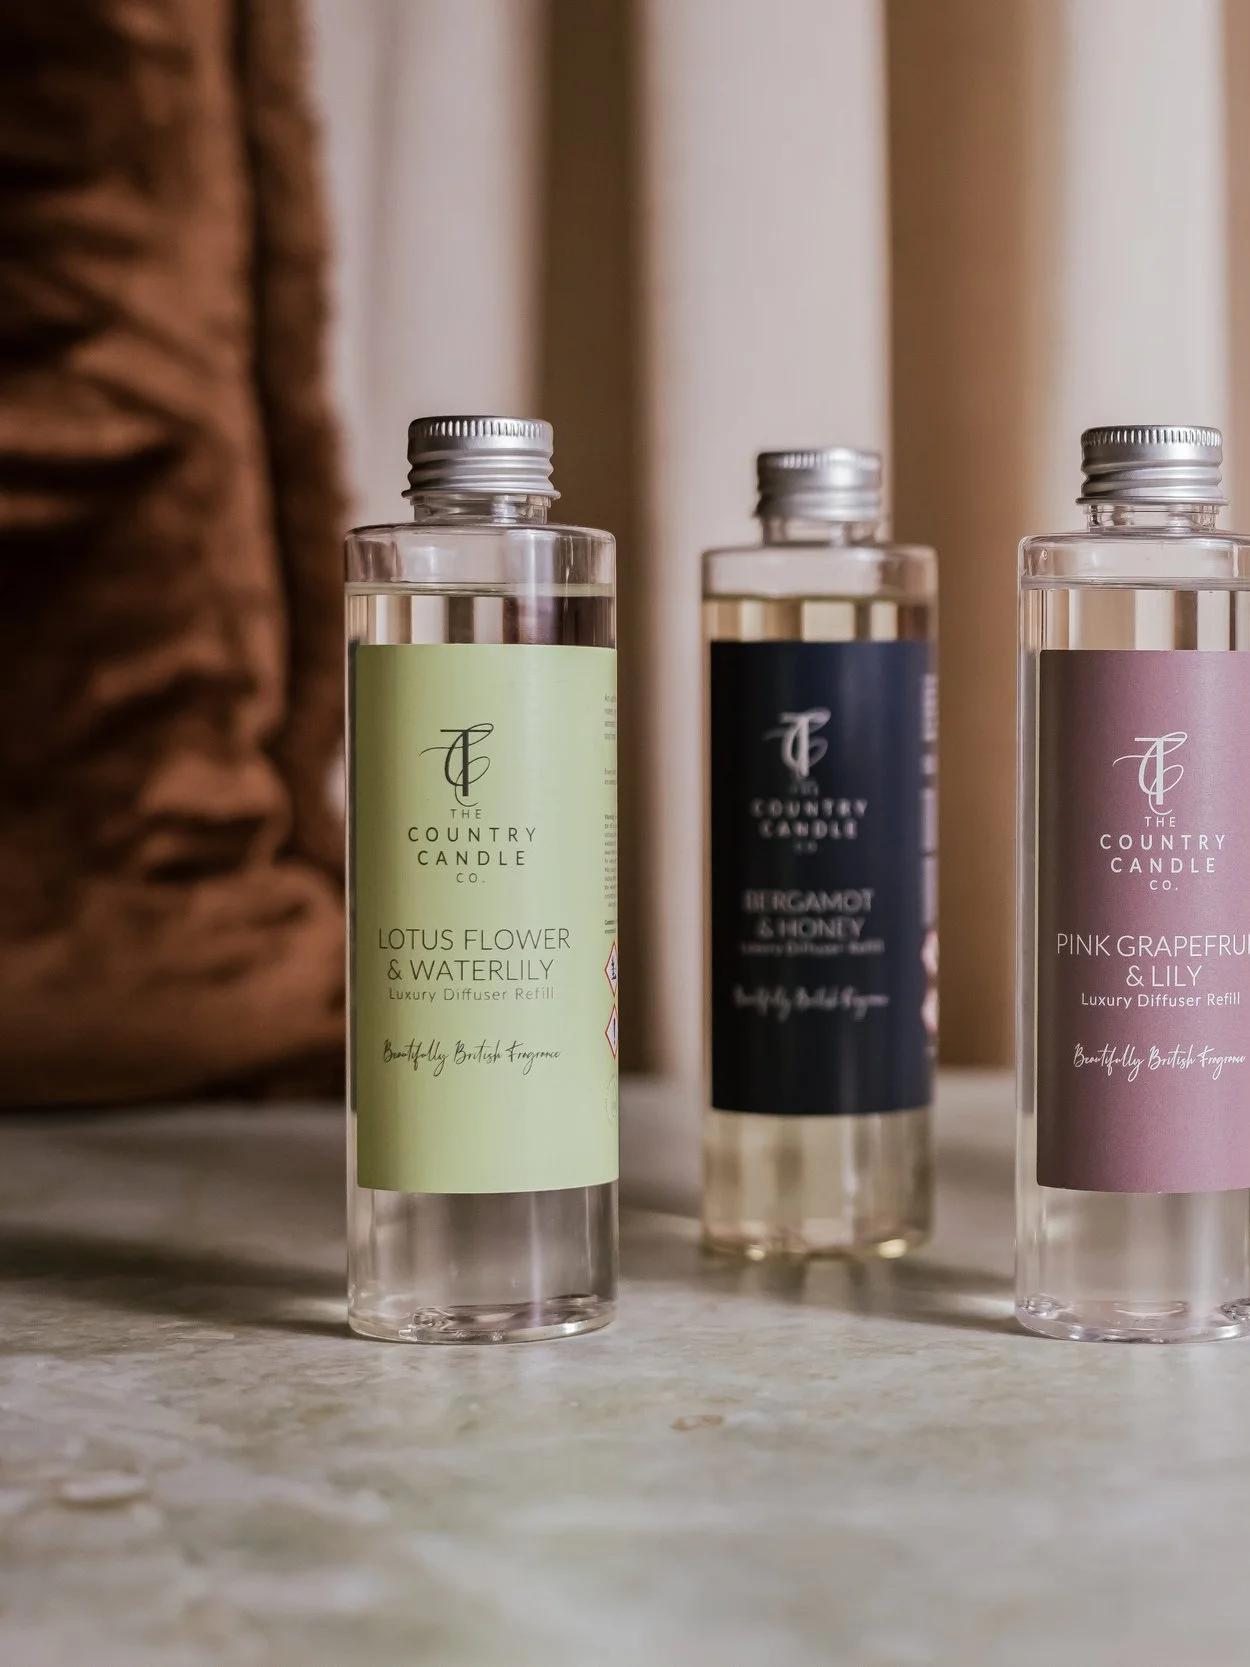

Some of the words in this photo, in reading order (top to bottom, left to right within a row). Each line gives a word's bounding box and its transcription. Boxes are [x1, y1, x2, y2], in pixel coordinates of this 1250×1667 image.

[450, 809, 482, 819] THE
[750, 798, 868, 818] COUNTRY
[758, 819, 858, 839] CANDLE
[1144, 816, 1176, 827] THE
[408, 827, 536, 842] COUNTRY
[1100, 834, 1226, 850] COUNTRY
[417, 850, 525, 866] CANDLE
[1110, 857, 1215, 873] CANDLE
[456, 873, 486, 883] CO.
[1149, 880, 1179, 890] CO.
[743, 888, 875, 914] BERGAMOT
[757, 917, 774, 938] &
[779, 917, 865, 938] HONEY
[379, 928, 454, 950] LOTUS
[464, 928, 571, 950] FLOWER
[1057, 933, 1111, 956] PINK
[387, 959, 402, 981] &
[409, 959, 554, 981] WATERLILY
[1126, 965, 1144, 987] &
[1152, 965, 1202, 987] LILY
[389, 988, 436, 1003] Luxury
[443, 988, 507, 1000] Diffuser
[515, 987, 554, 1000] Refill
[1081, 993, 1132, 1009] Luxury
[1137, 994, 1201, 1007] Diffuser
[1207, 992, 1240, 1006] Refill
[383, 1038, 449, 1077] Beautifully
[454, 1039, 503, 1065] British
[504, 1040, 561, 1076] Fragrance
[1073, 1043, 1144, 1082] Beautifully
[1147, 1044, 1195, 1070] British
[1196, 1045, 1246, 1080] Fragrance
